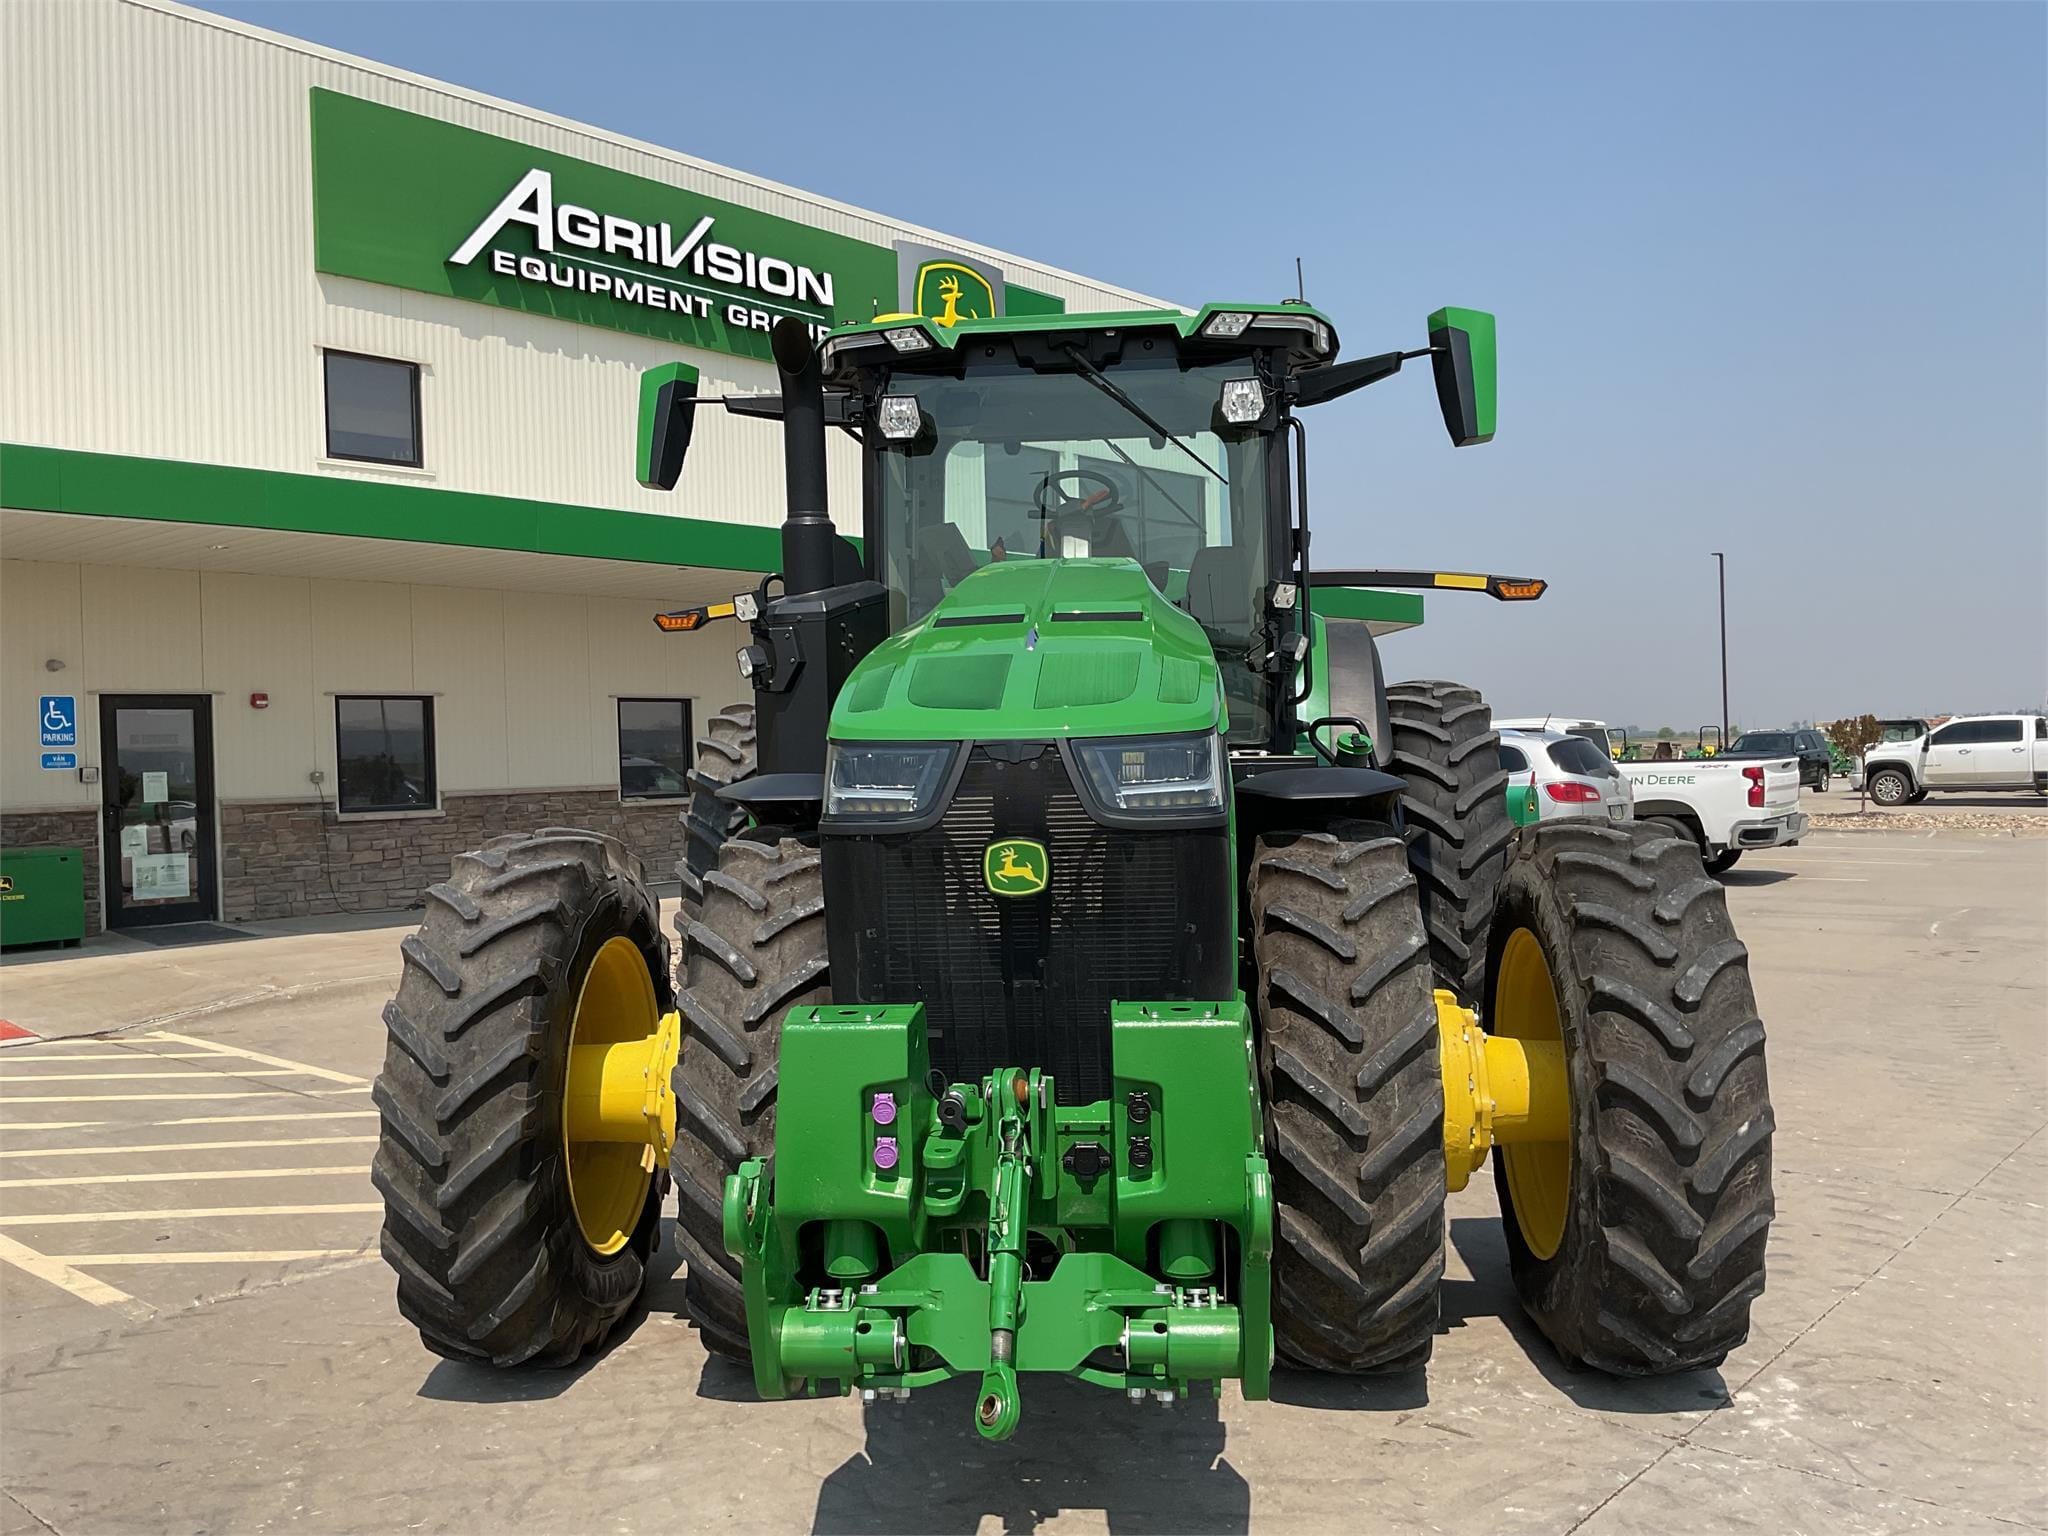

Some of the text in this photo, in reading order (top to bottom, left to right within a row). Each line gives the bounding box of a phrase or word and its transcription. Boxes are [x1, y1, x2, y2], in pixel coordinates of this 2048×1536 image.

[449, 168, 834, 306] AGRIVISION
[493, 249, 833, 342] EQUIPMENT GRP
[43, 733, 74, 742] PARKING
[1647, 774, 1696, 785] DEERE
